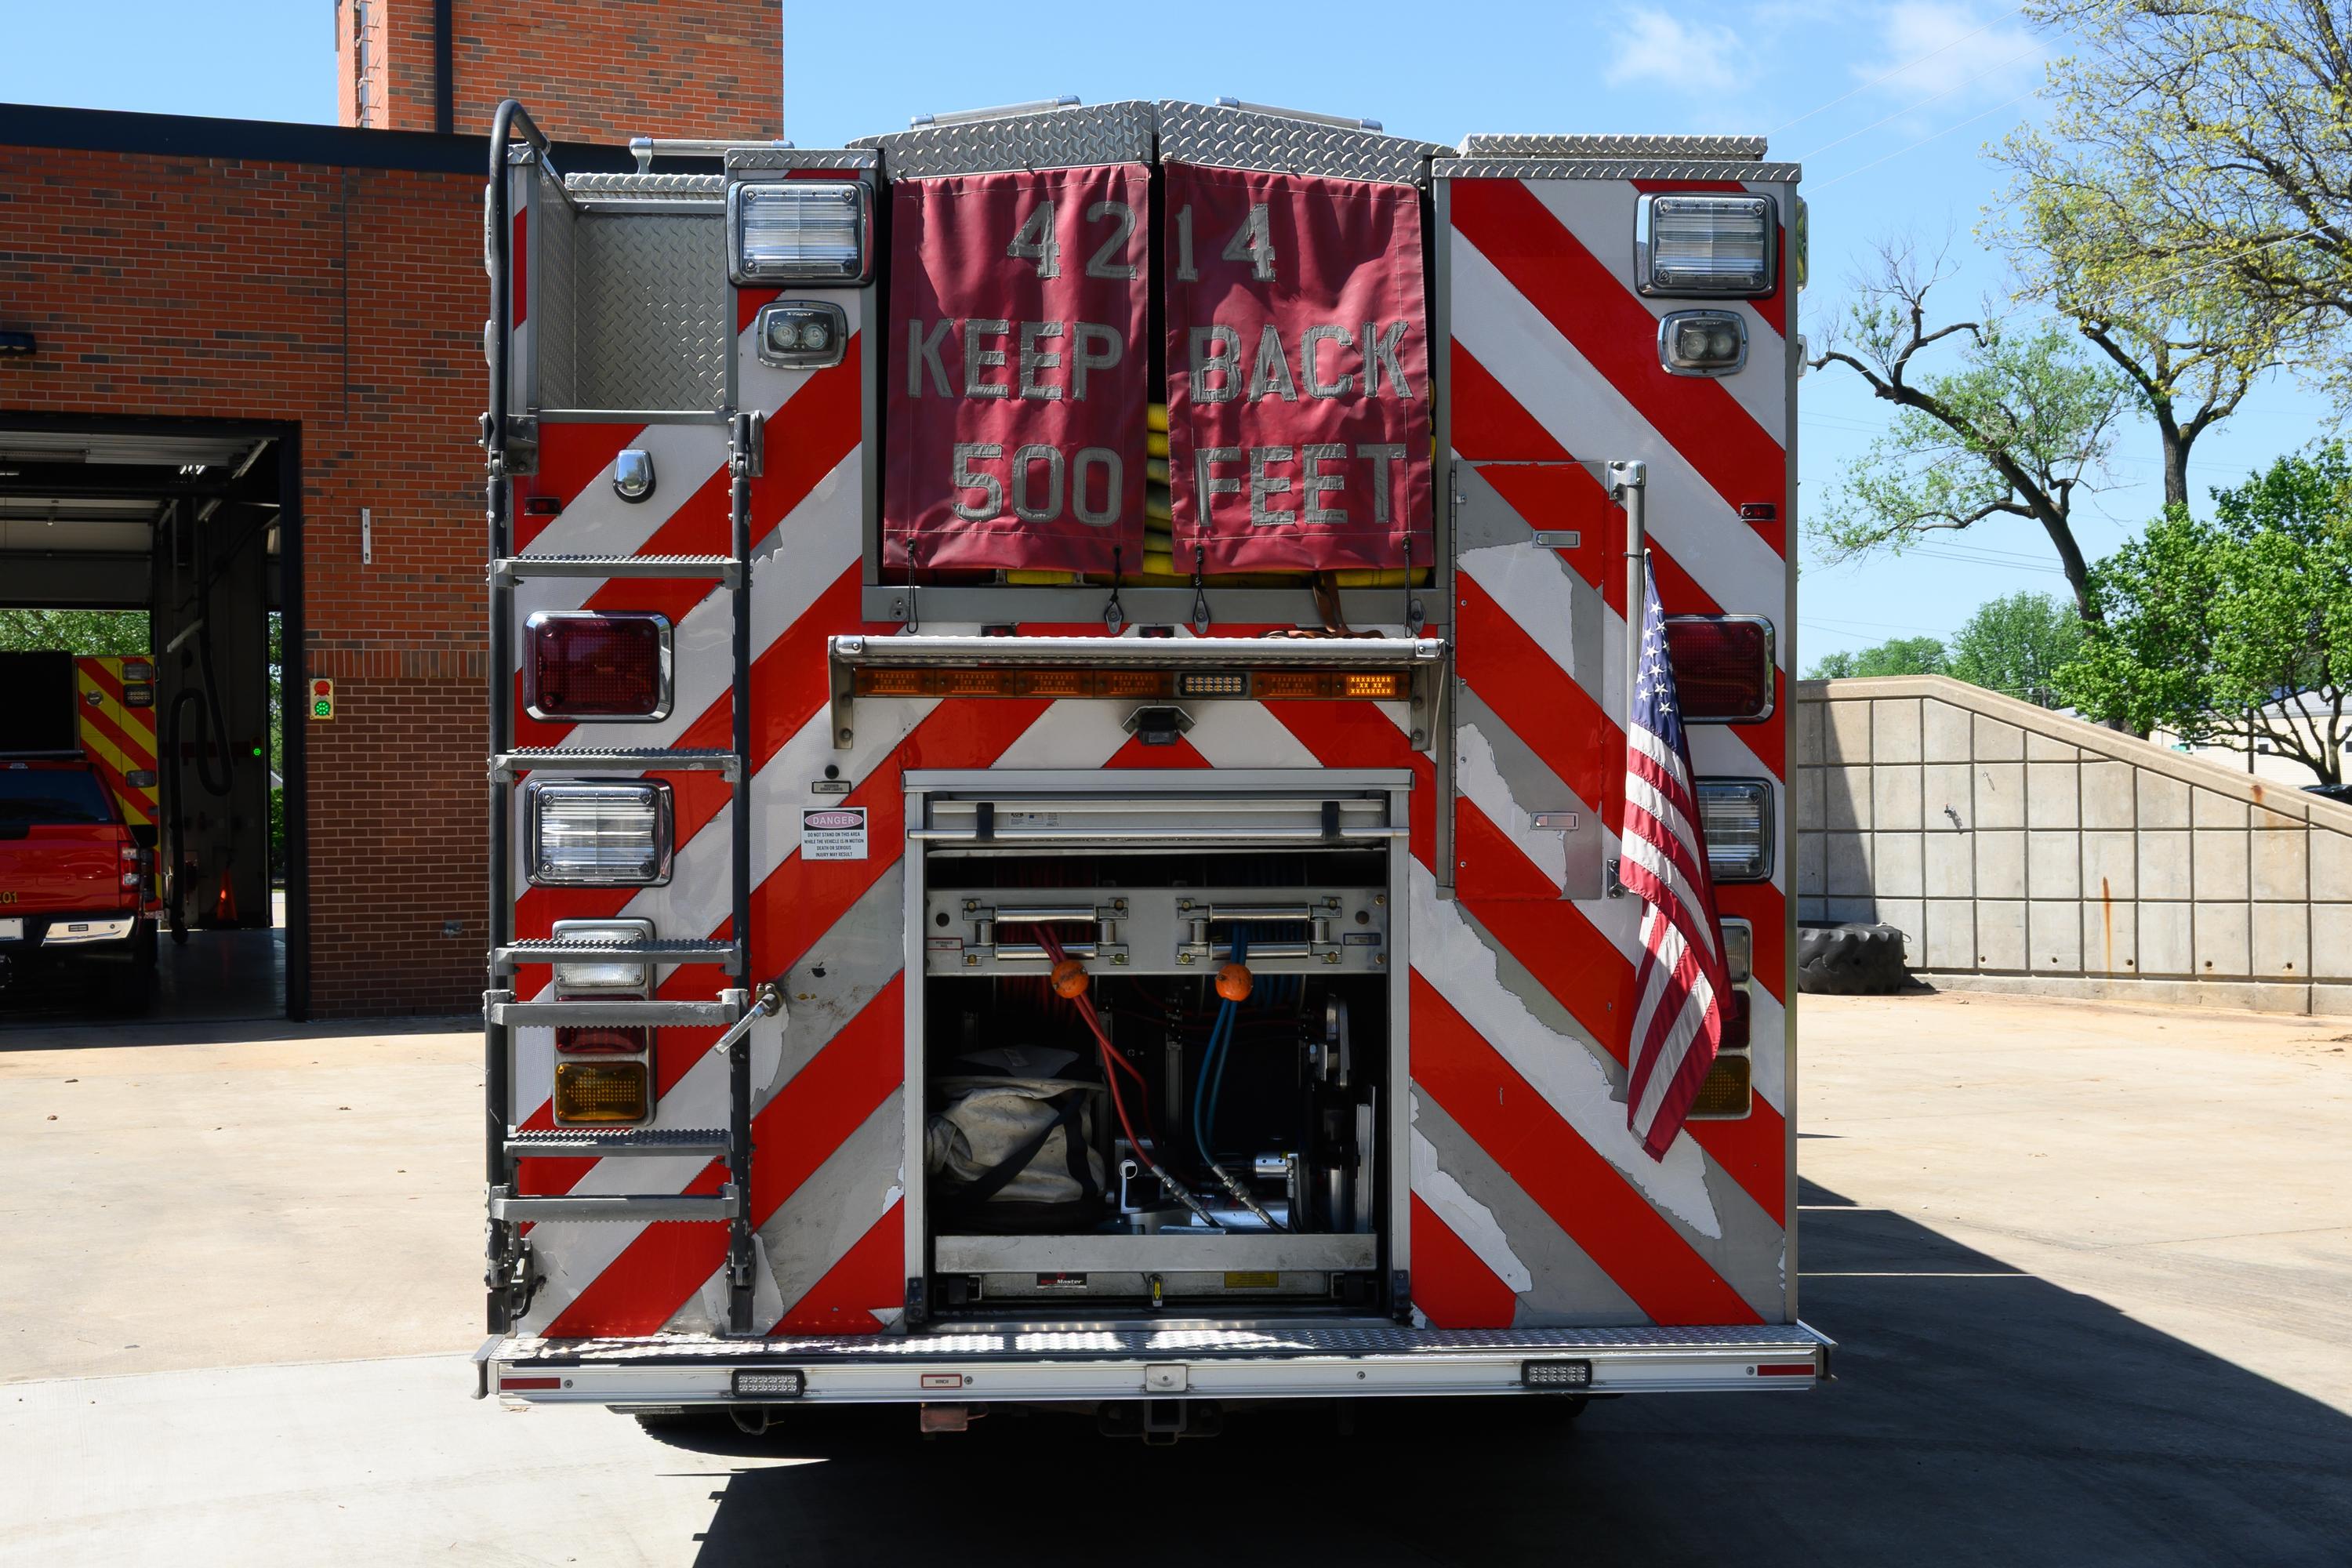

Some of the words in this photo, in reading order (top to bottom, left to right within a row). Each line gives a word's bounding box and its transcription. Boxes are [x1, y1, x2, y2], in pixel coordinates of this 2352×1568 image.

[907, 318, 1123, 401] KEEP
[1188, 321, 1414, 404] BACK
[952, 442, 1123, 528] 500
[1194, 443, 1408, 528] FEET
[812, 816, 855, 825] DANGER
